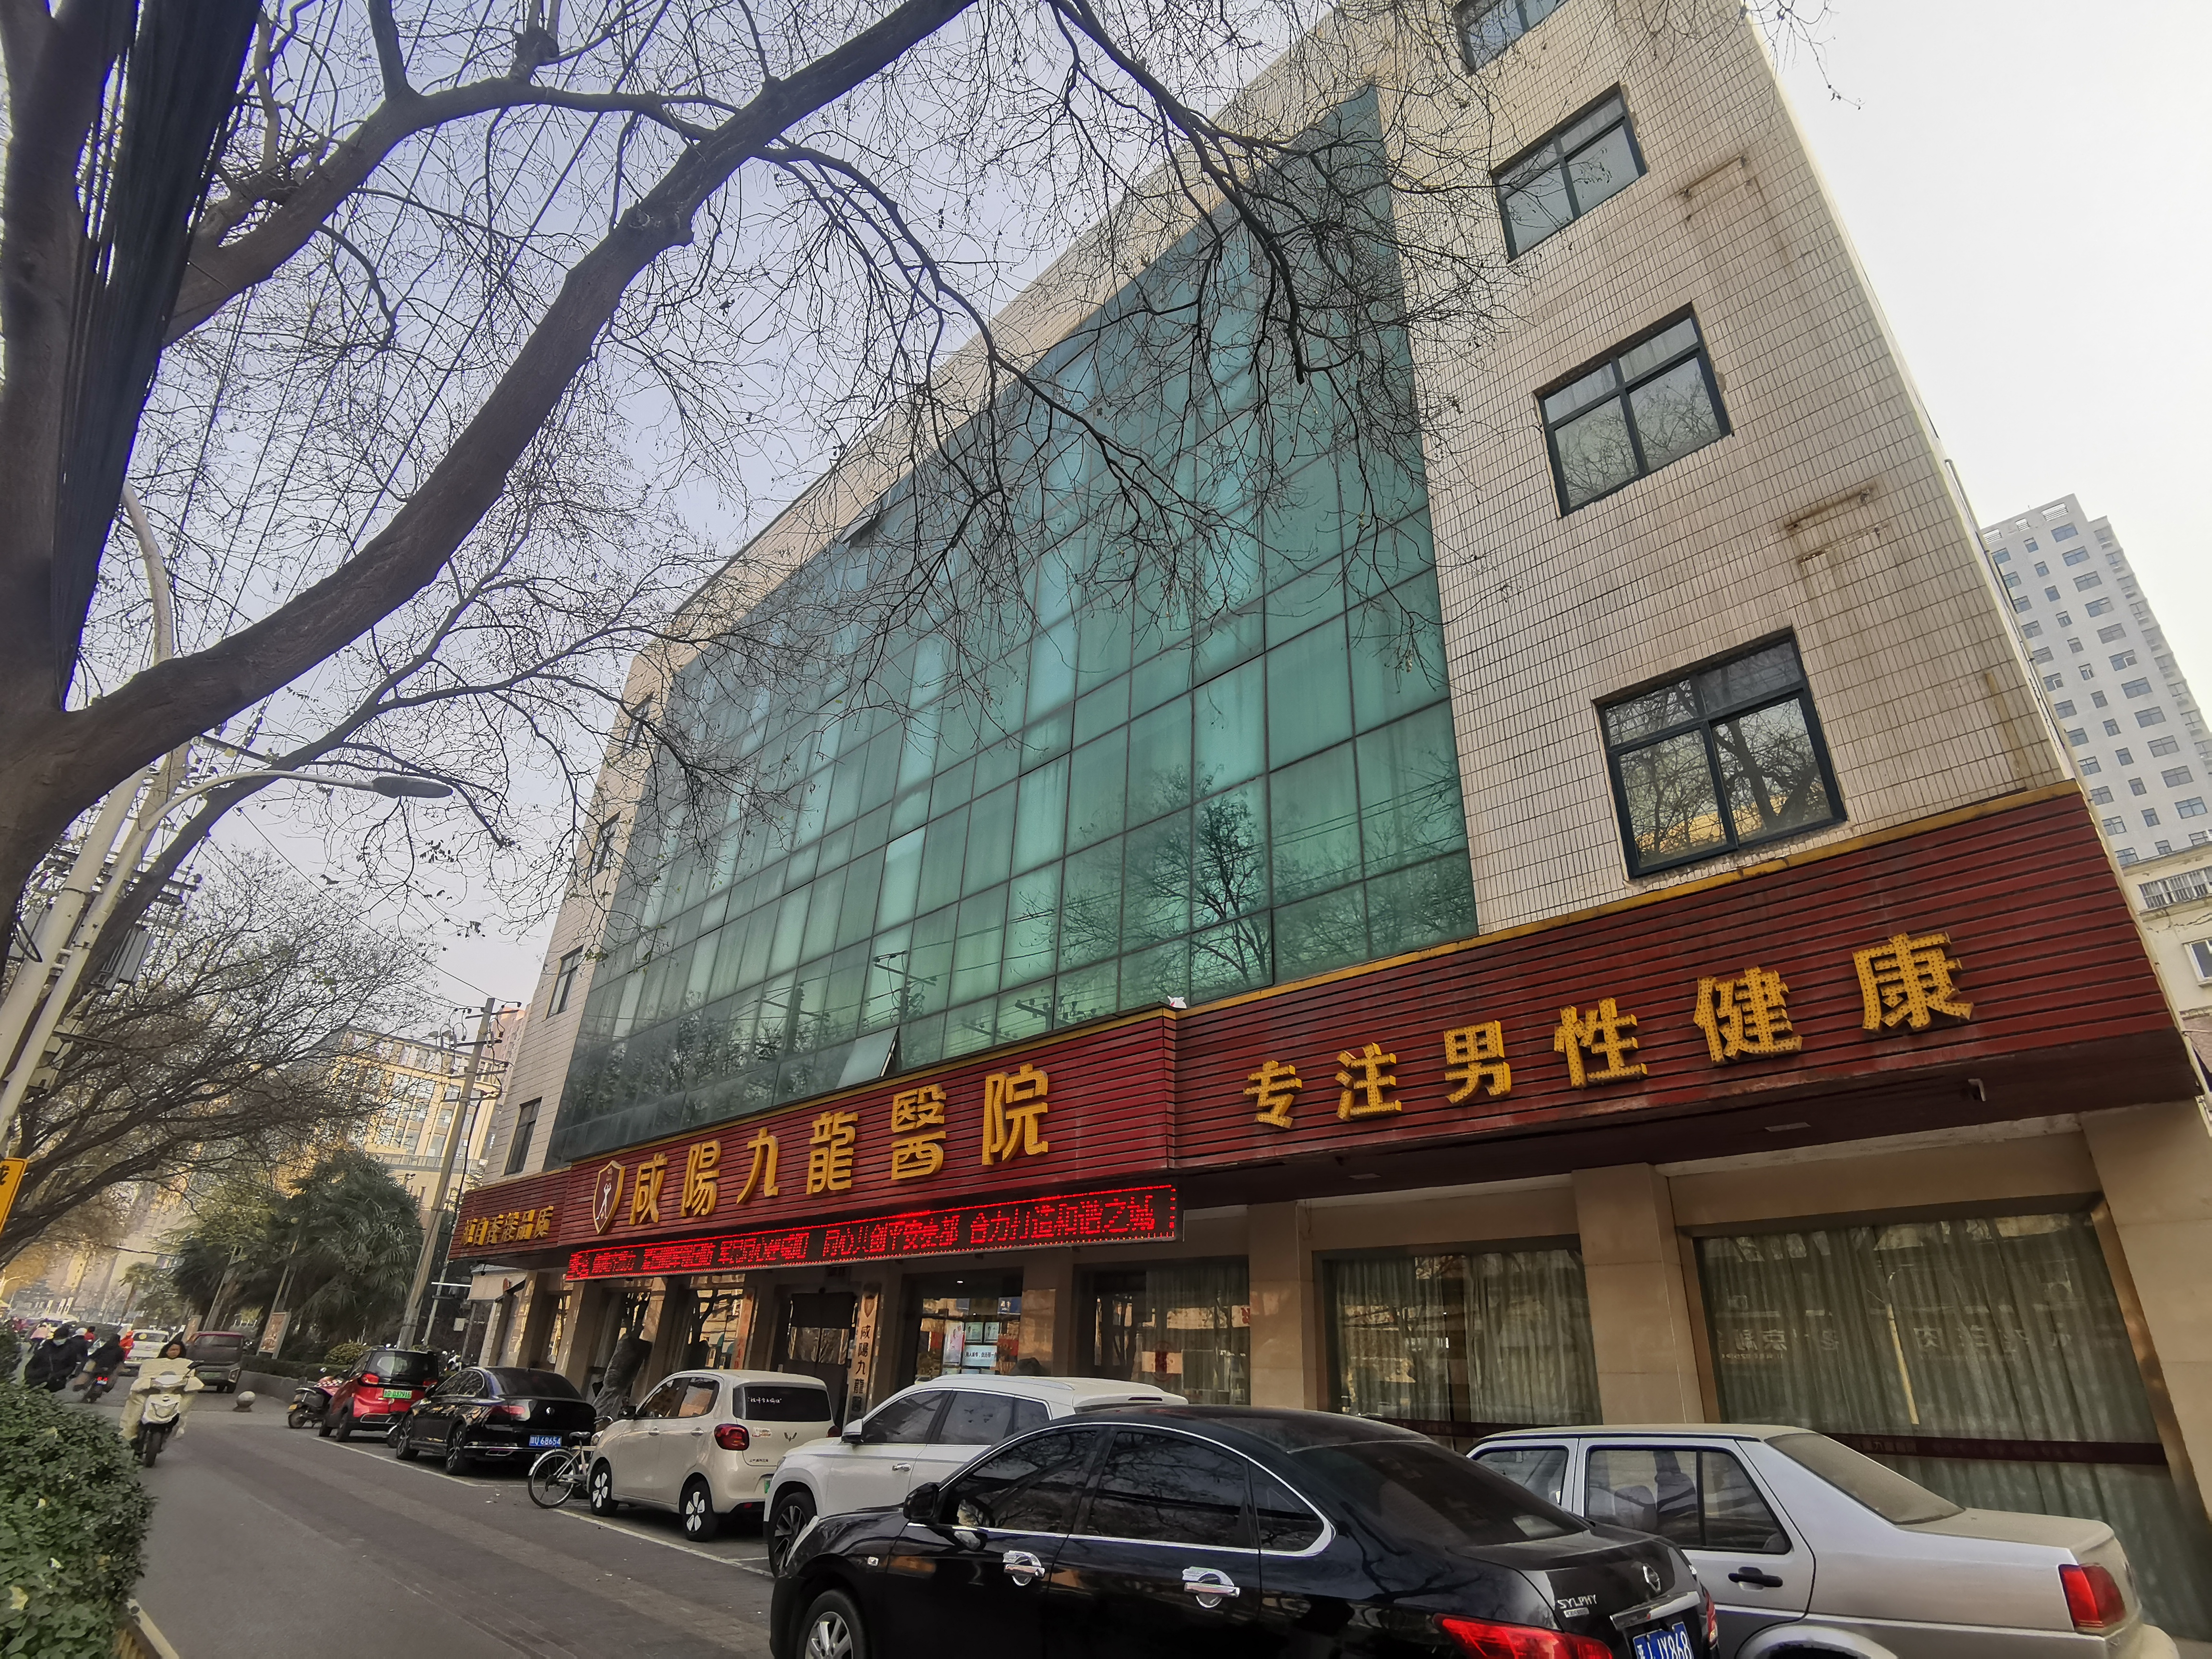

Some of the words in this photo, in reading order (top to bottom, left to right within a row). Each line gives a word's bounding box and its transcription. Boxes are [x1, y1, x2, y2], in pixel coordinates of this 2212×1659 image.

[1242, 932, 1973, 1129] 专注男性健康
[628, 1063, 1048, 1226] 咸陽九龍醫院
[971, 1195, 1155, 1244] 合力打造和谐之城
[1557, 1594, 1597, 1609] SYLPHY
